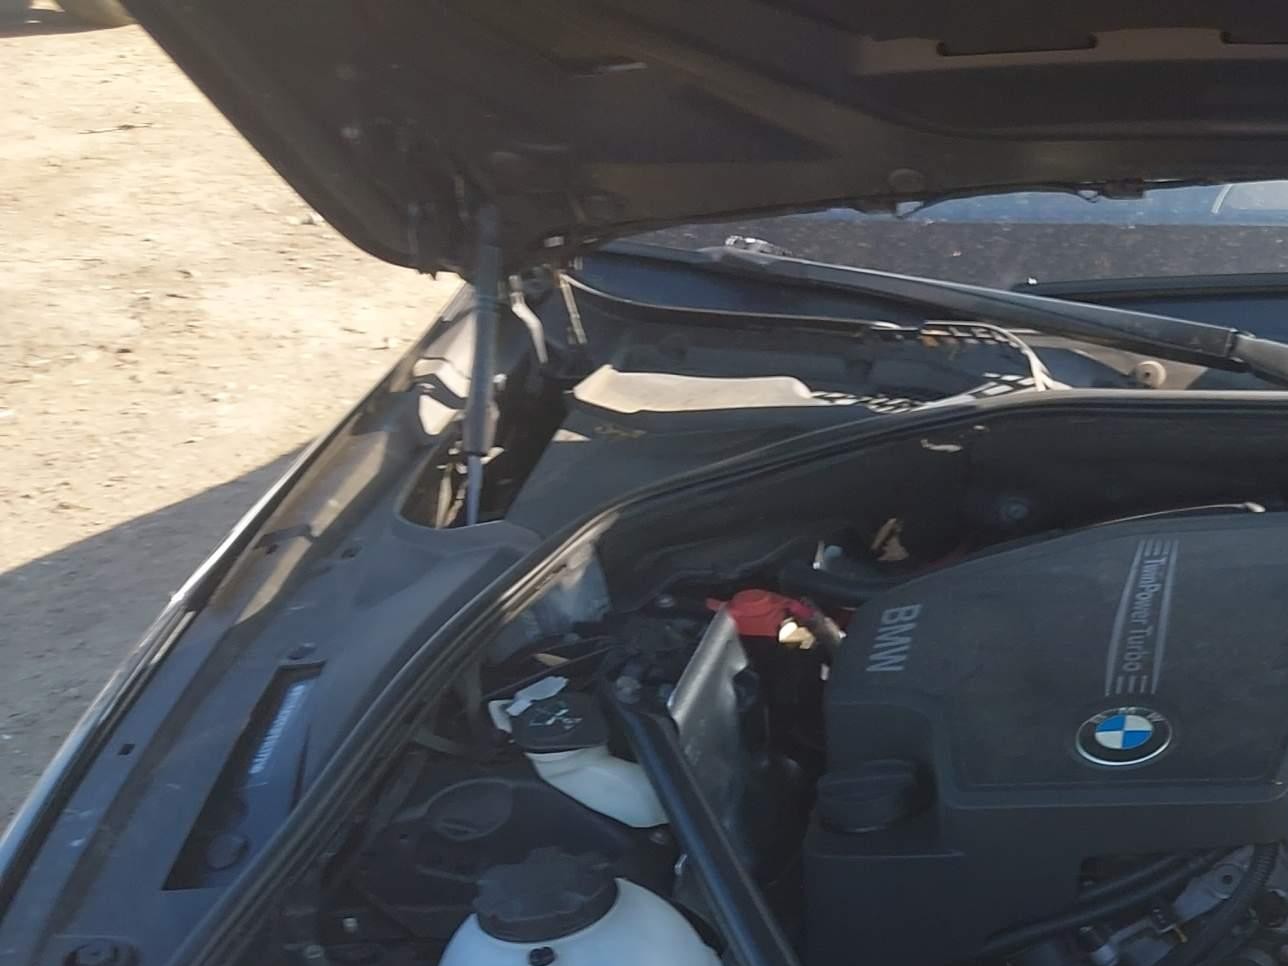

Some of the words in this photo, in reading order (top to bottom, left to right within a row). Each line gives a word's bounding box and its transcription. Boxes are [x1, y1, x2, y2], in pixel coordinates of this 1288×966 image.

[1131, 556, 1168, 625] TwinPower
[865, 603, 922, 672] BMW
[1122, 625, 1154, 672] Turbo
